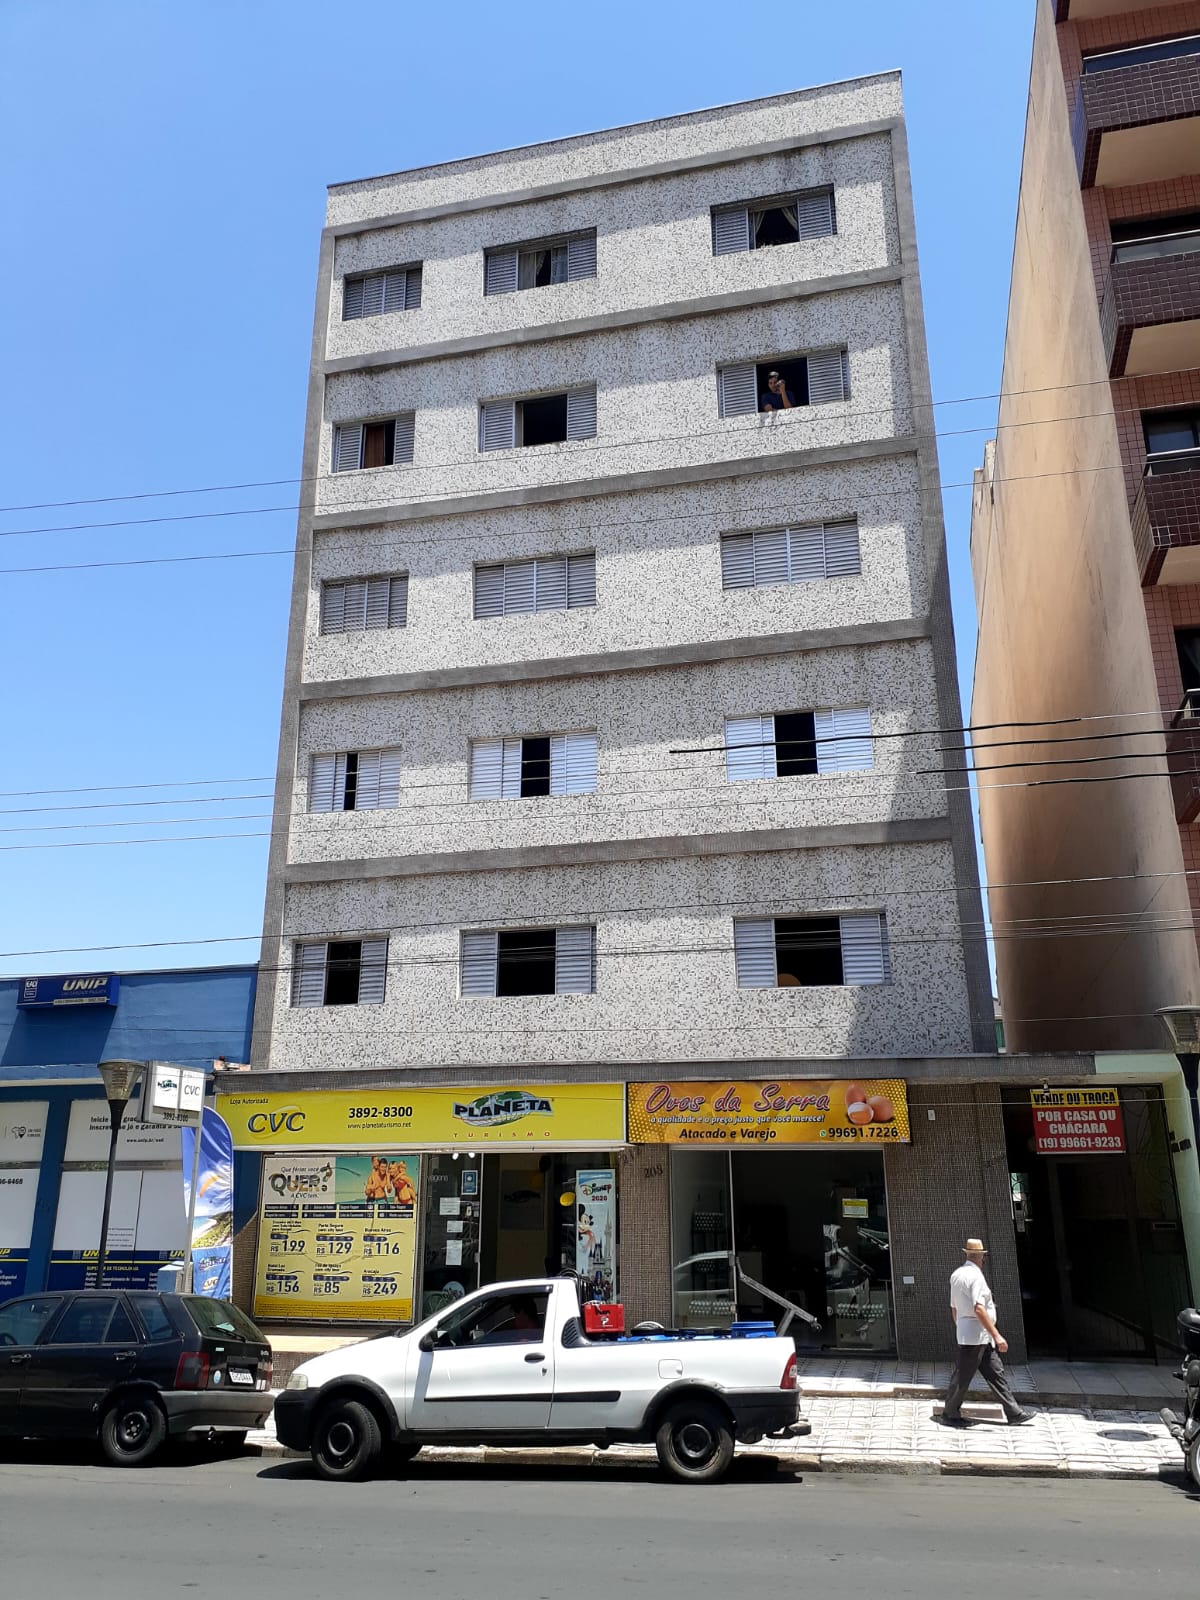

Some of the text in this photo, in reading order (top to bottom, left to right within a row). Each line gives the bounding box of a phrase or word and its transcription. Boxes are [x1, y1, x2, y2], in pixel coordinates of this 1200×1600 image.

[62, 978, 108, 991] UNIP
[184, 1085, 200, 1096] CVC
[645, 1083, 831, 1113] Ovos da Serra
[1034, 1092, 1116, 1105] VENDE OU TROCA
[348, 1106, 413, 1119] 3892-8300
[454, 1099, 553, 1117] PLANETA
[657, 1115, 696, 1125] qualidade
[711, 1116, 733, 1125] preço
[733, 1115, 754, 1125] justo
[756, 1116, 771, 1124] que
[773, 1114, 790, 1123] você
[792, 1114, 825, 1123] merece!
[1037, 1110, 1116, 1122] POR CASA OU
[247, 1112, 306, 1133] CVC
[1049, 1122, 1108, 1134] CHÁCARA
[680, 1128, 777, 1141] Atacado e Varejo
[828, 1127, 899, 1138] 99691.7226
[1038, 1136, 1122, 1148] (19) 99661-9233
[281, 1166, 292, 1174] Que
[282, 1240, 306, 1252] 199
[328, 1242, 352, 1254] 129
[376, 1242, 400, 1255] 116
[277, 1281, 300, 1293] 156
[324, 1281, 340, 1294] 85
[373, 1282, 398, 1295] 249
